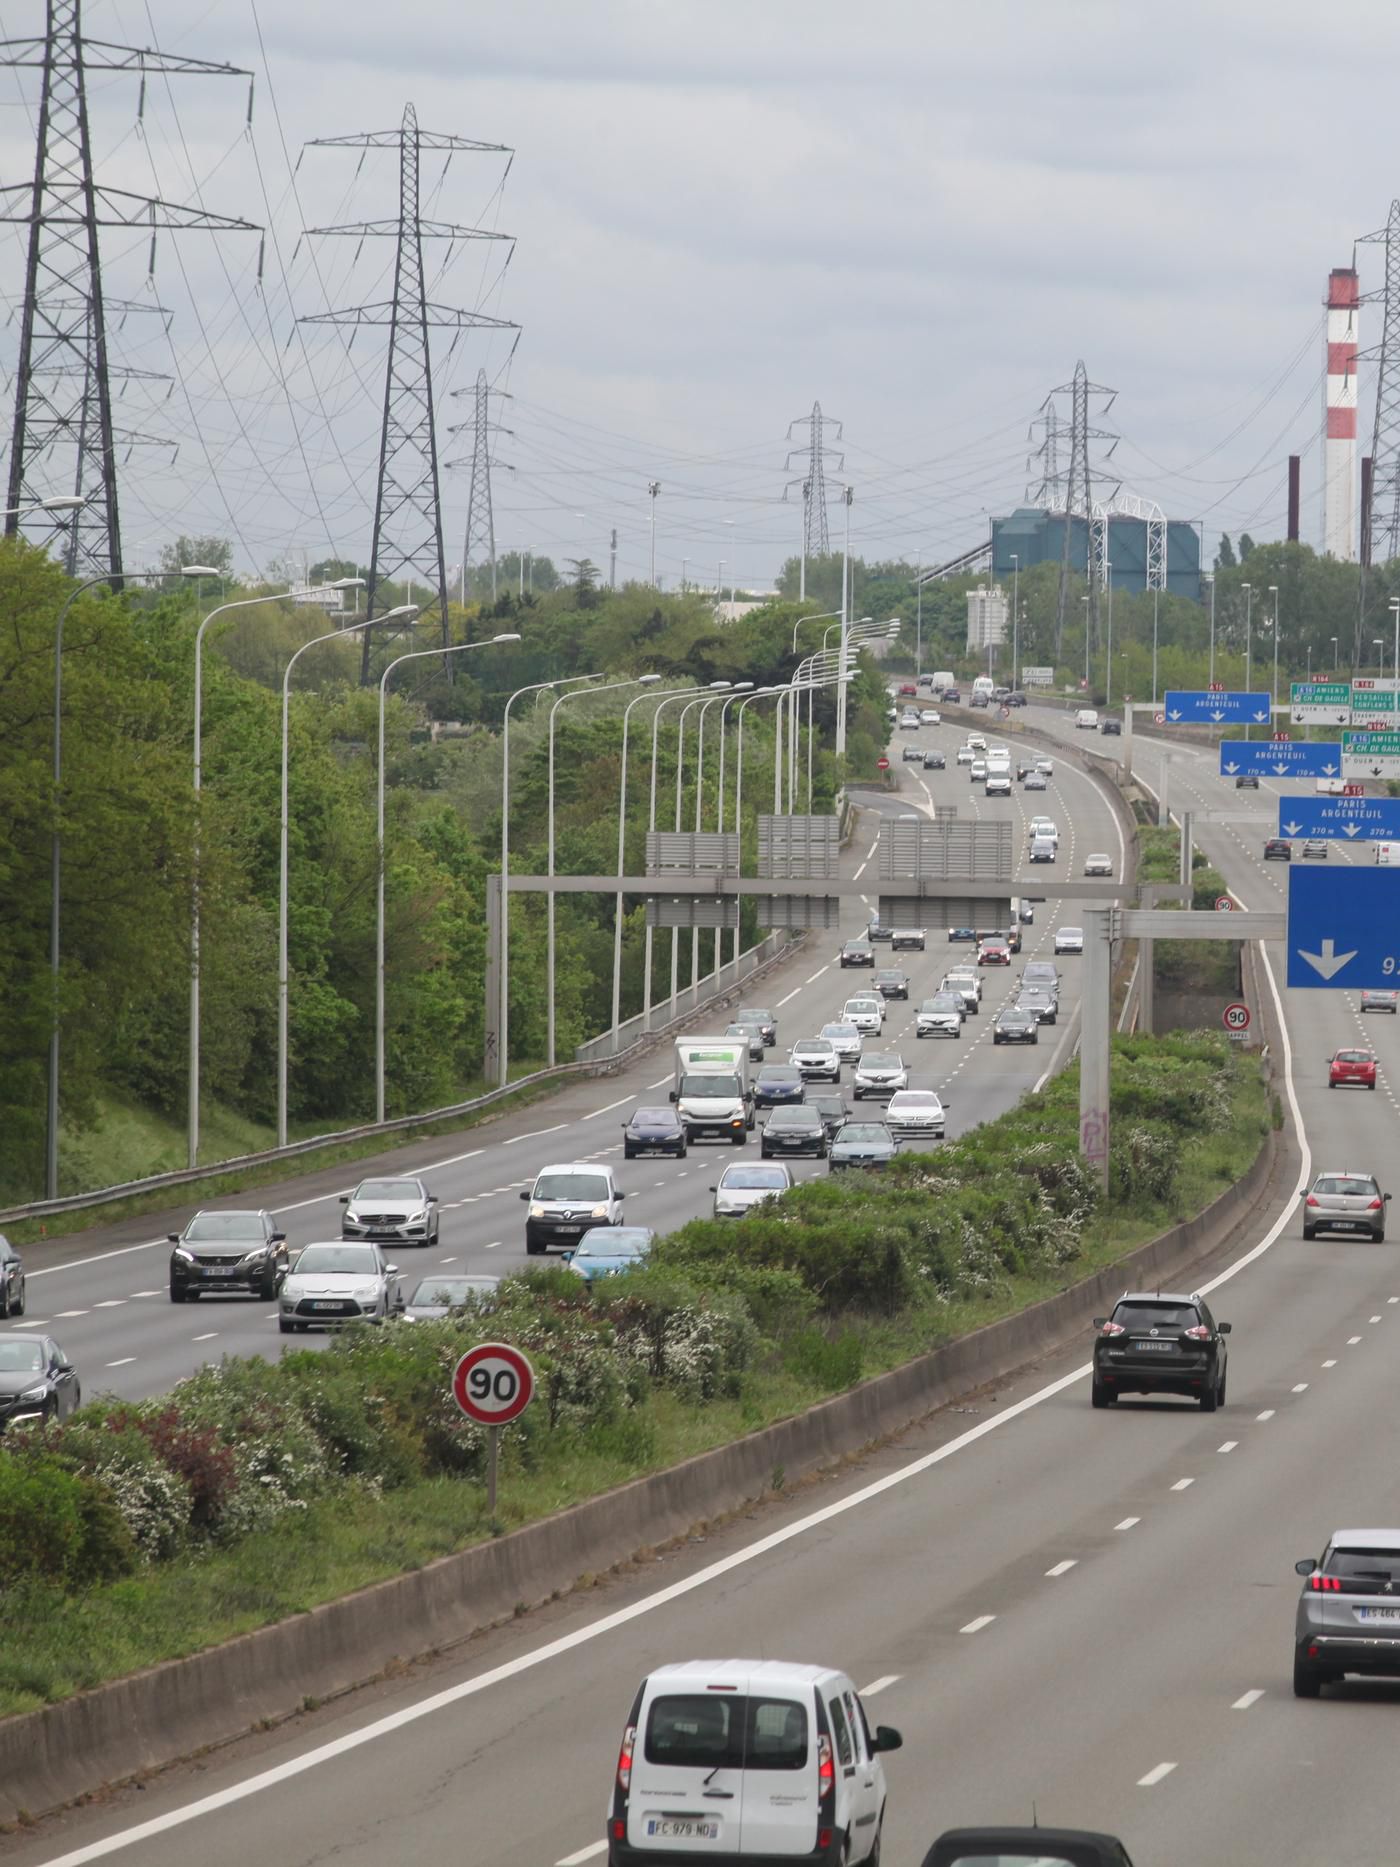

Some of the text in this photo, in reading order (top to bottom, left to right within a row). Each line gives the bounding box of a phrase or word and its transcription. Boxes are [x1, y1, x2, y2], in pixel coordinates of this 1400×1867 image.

[1255, 752, 1307, 760] ARGENTEUIL
[1337, 800, 1366, 808] PARIS
[1321, 809, 1382, 819] ARGENTEUIL
[1370, 828, 1385, 836] 370
[1229, 1012, 1245, 1022] 90
[470, 1368, 516, 1401] 90
